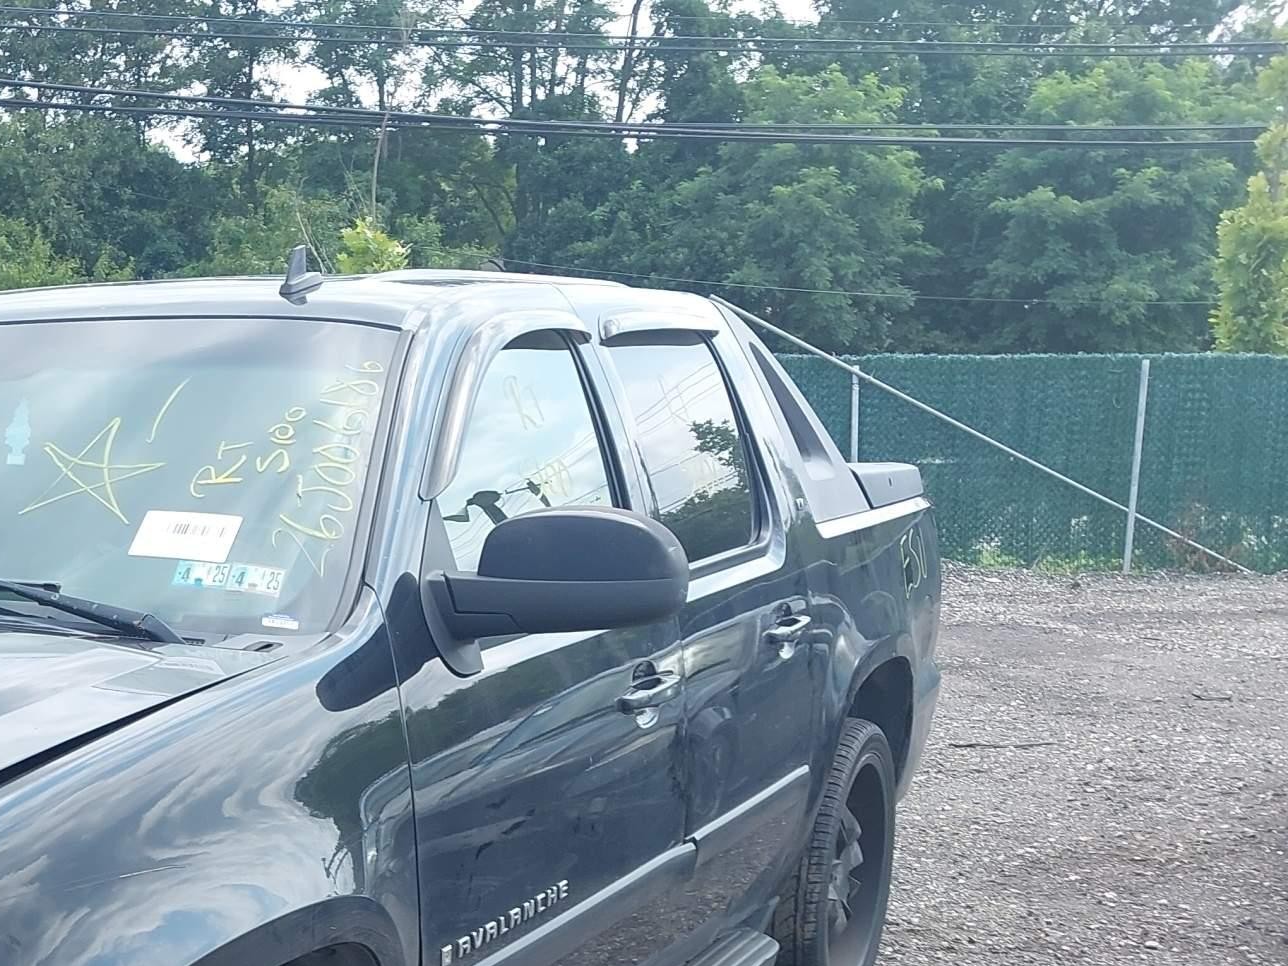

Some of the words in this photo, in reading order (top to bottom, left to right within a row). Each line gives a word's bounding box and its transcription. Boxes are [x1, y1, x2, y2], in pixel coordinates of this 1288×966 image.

[212, 565, 228, 584] 25
[266, 571, 282, 591] 25
[456, 879, 569, 959] AVALANCHE
